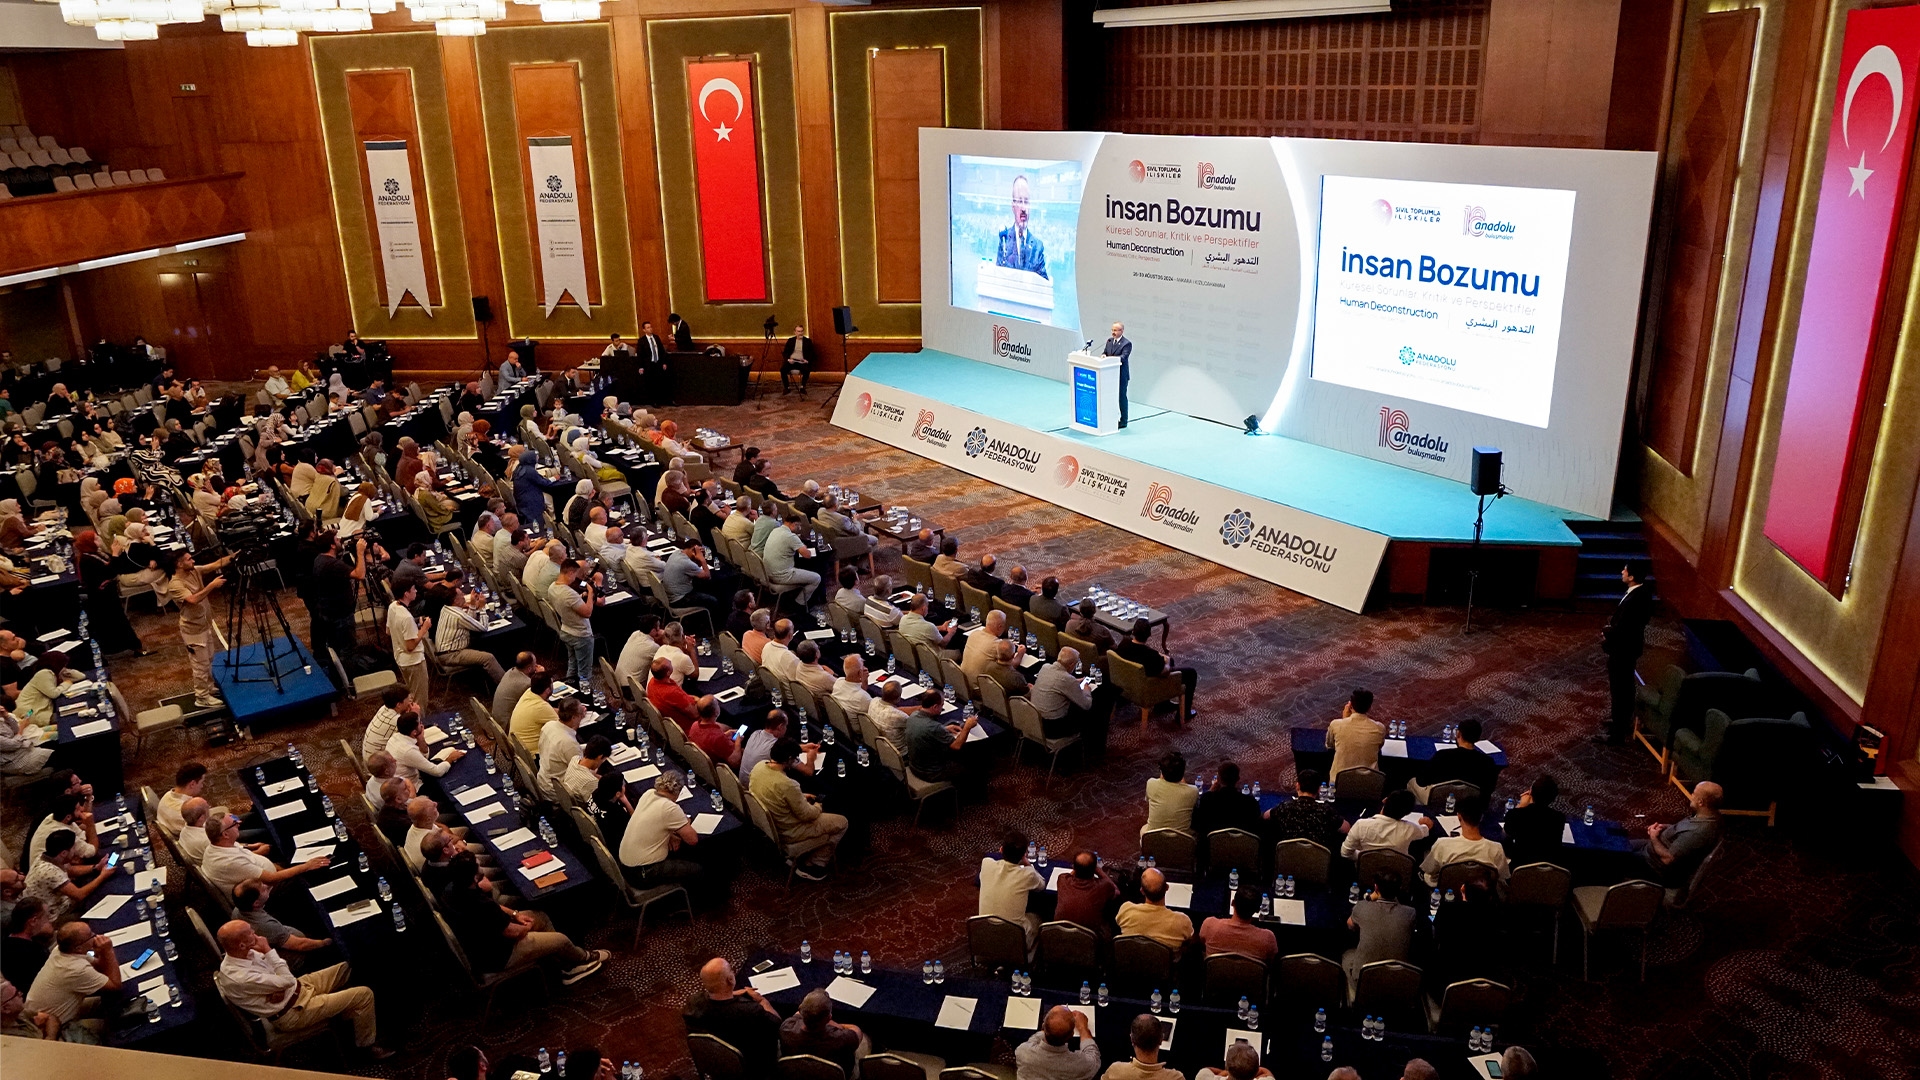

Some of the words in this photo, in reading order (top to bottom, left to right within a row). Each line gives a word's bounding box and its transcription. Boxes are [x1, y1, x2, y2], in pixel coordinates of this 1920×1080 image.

[1206, 174, 1236, 185] anadolu
[1106, 194, 1162, 223] İnsan
[1166, 199, 1260, 232] Bozumu
[1474, 221, 1516, 233] anadolu
[1106, 225, 1133, 235] Küresel
[1170, 231, 1191, 241] Kritik
[1193, 234, 1202, 243] ve
[1204, 234, 1259, 248] Perspektifler
[1106, 240, 1130, 250] Human
[1131, 242, 1184, 256] Deconstruction
[1342, 246, 1412, 280] İnsan
[1418, 255, 1540, 297] Bozumu
[1340, 297, 1369, 309] Human
[1370, 301, 1438, 319] Deconstruction
[1452, 297, 1463, 306] ve
[1466, 318, 1498, 330] البشري
[1502, 325, 1534, 334] التدهور
[1002, 342, 1031, 356] anadolu
[1417, 353, 1457, 366] ANADOLU
[922, 426, 952, 442] anadolu
[1394, 431, 1449, 453] anadolu
[988, 439, 1041, 465] ANADOLU
[1408, 447, 1446, 462] buluşmaları
[983, 450, 1036, 473] FEDERASYONU
[1096, 473, 1128, 489] TOPLUMLA
[1155, 504, 1200, 525] anadolu
[1162, 519, 1194, 534] buluşmaları
[1254, 525, 1337, 562] ANADOLU
[1249, 539, 1331, 574] FEDERASYONU
